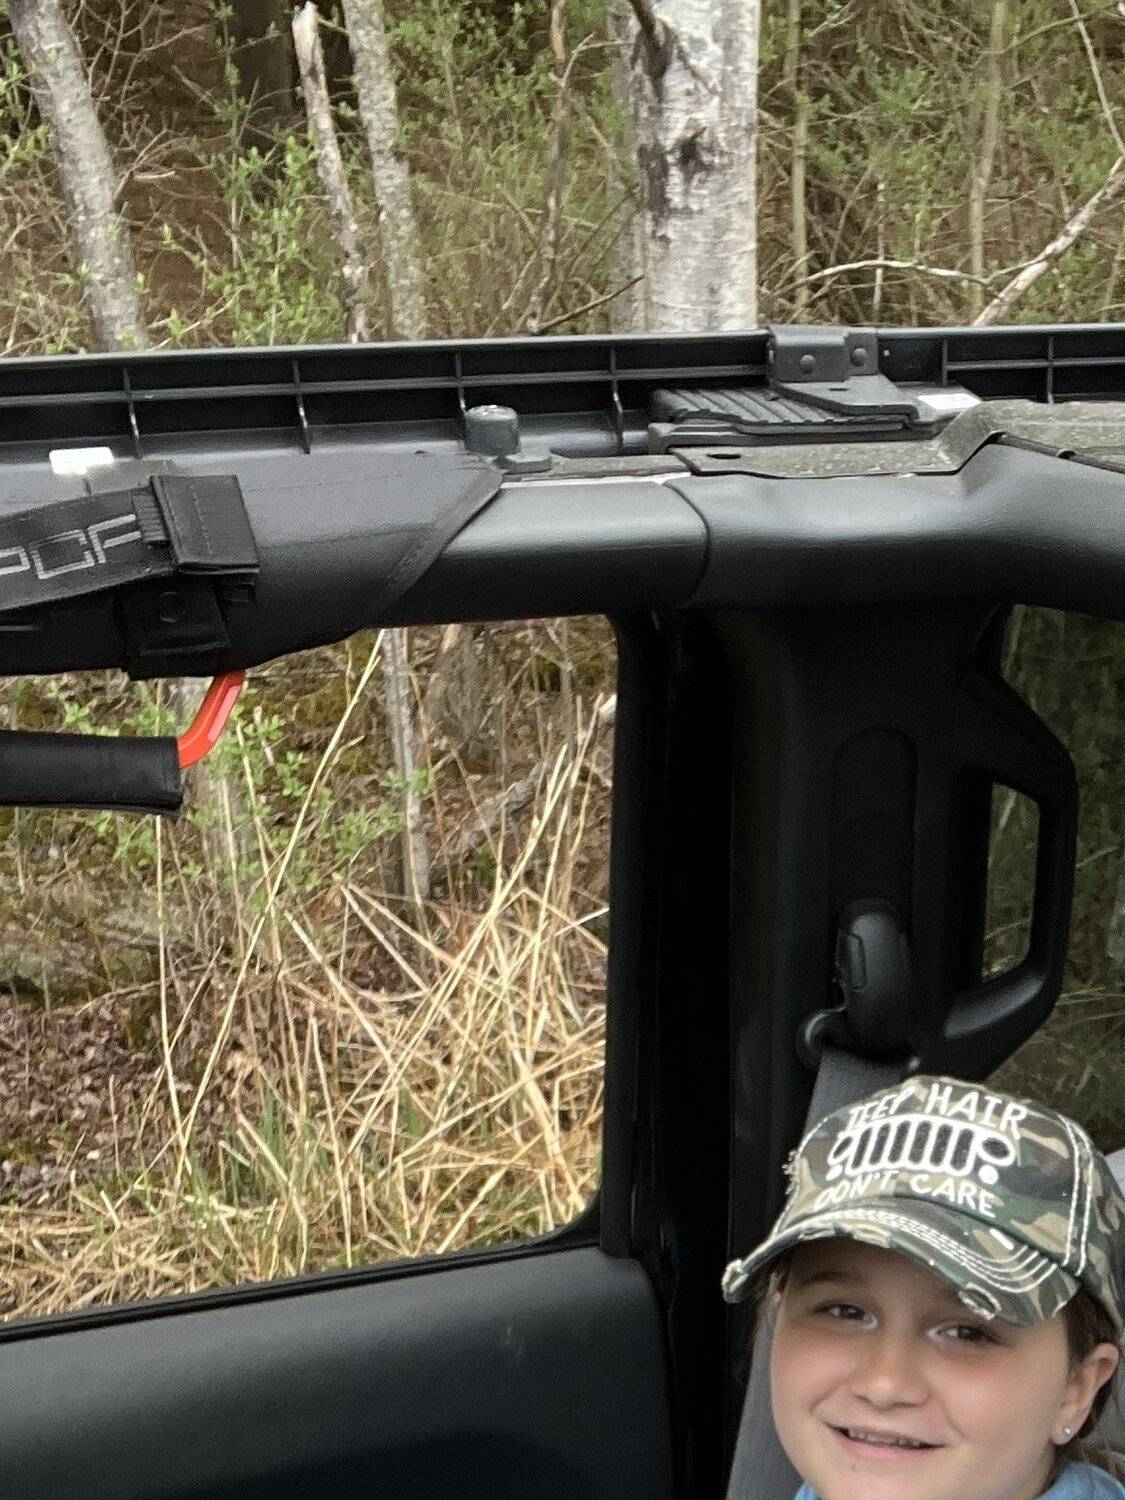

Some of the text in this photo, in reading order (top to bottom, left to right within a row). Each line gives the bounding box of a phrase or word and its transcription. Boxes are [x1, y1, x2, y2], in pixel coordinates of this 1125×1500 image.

[925, 1083, 1027, 1140] HAIR
[813, 1169, 996, 1218] DON'T CARE
